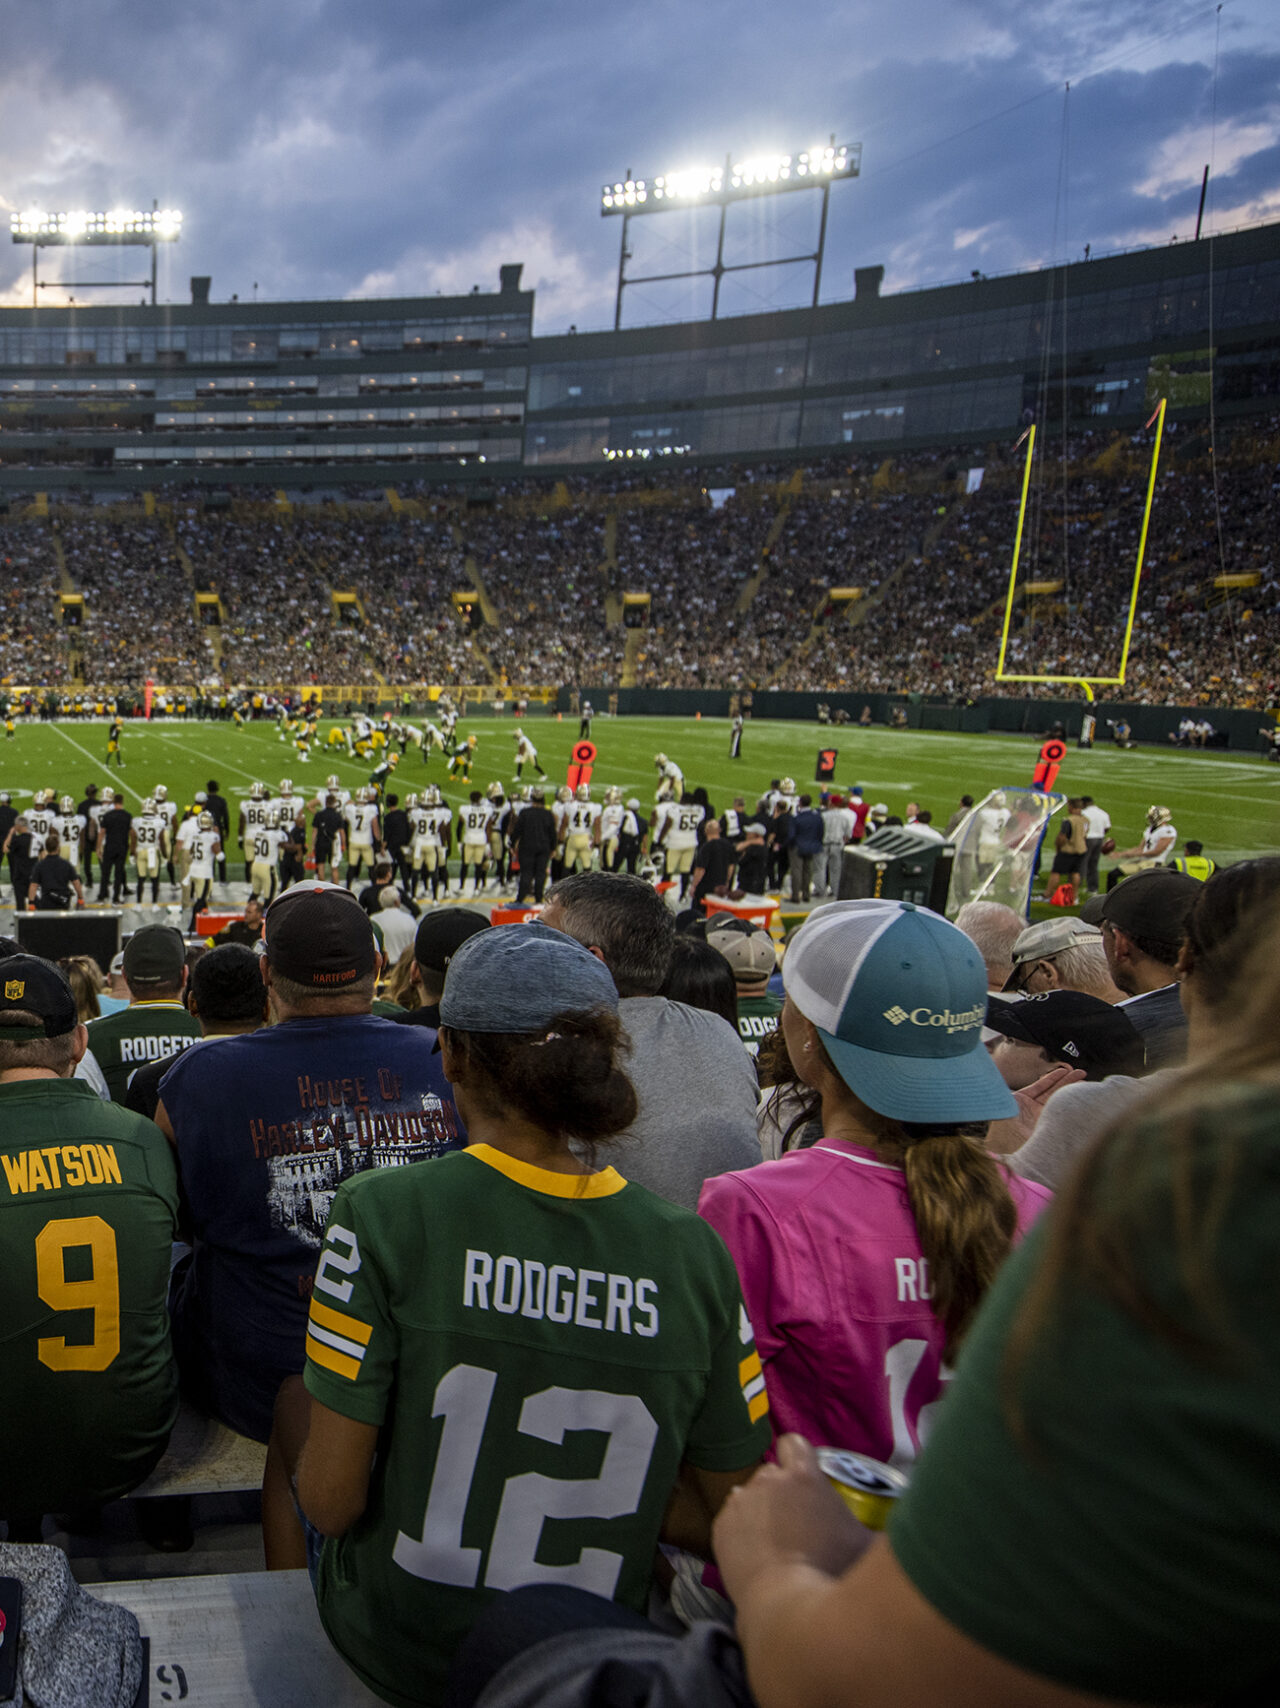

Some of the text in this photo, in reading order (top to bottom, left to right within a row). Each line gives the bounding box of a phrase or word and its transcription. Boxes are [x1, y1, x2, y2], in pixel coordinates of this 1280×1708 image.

[281, 807, 295, 822] 81
[468, 813, 486, 829] 87
[573, 811, 591, 828] 44
[680, 814, 698, 831] 65
[138, 828, 156, 843] 33
[313, 969, 357, 984] HARTFORD
[297, 1075, 370, 1109] HOUSE
[249, 1098, 458, 1159] HARLEY-DAVIDSON
[0, 1144, 123, 1195] WATSON
[35, 1215, 121, 1372] 9
[463, 1248, 660, 1338] RODGERS
[392, 1363, 659, 1600] 12
